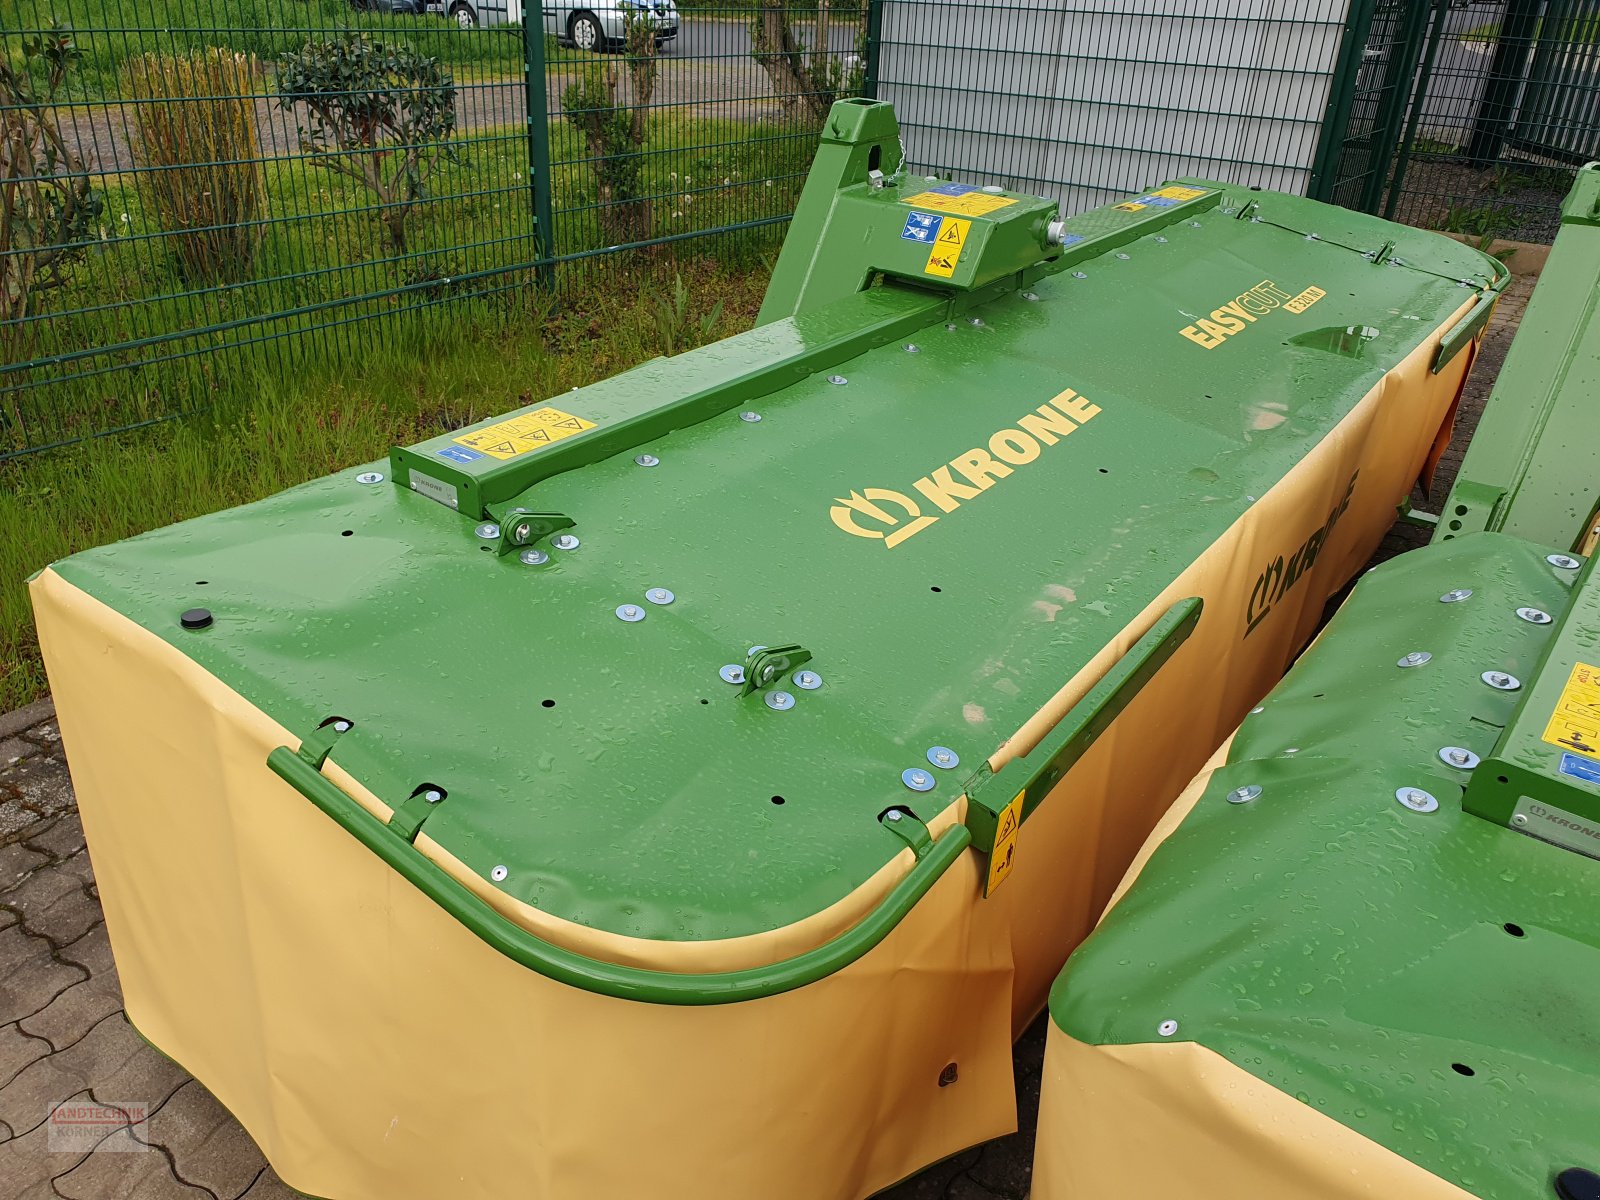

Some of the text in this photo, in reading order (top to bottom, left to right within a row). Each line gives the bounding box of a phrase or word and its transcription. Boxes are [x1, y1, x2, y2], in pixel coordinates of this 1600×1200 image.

[1178, 279, 1292, 350] EASYCUT
[1288, 288, 1323, 312] F 320 M
[912, 387, 1103, 514] KRONE
[1275, 467, 1360, 605] KRE
